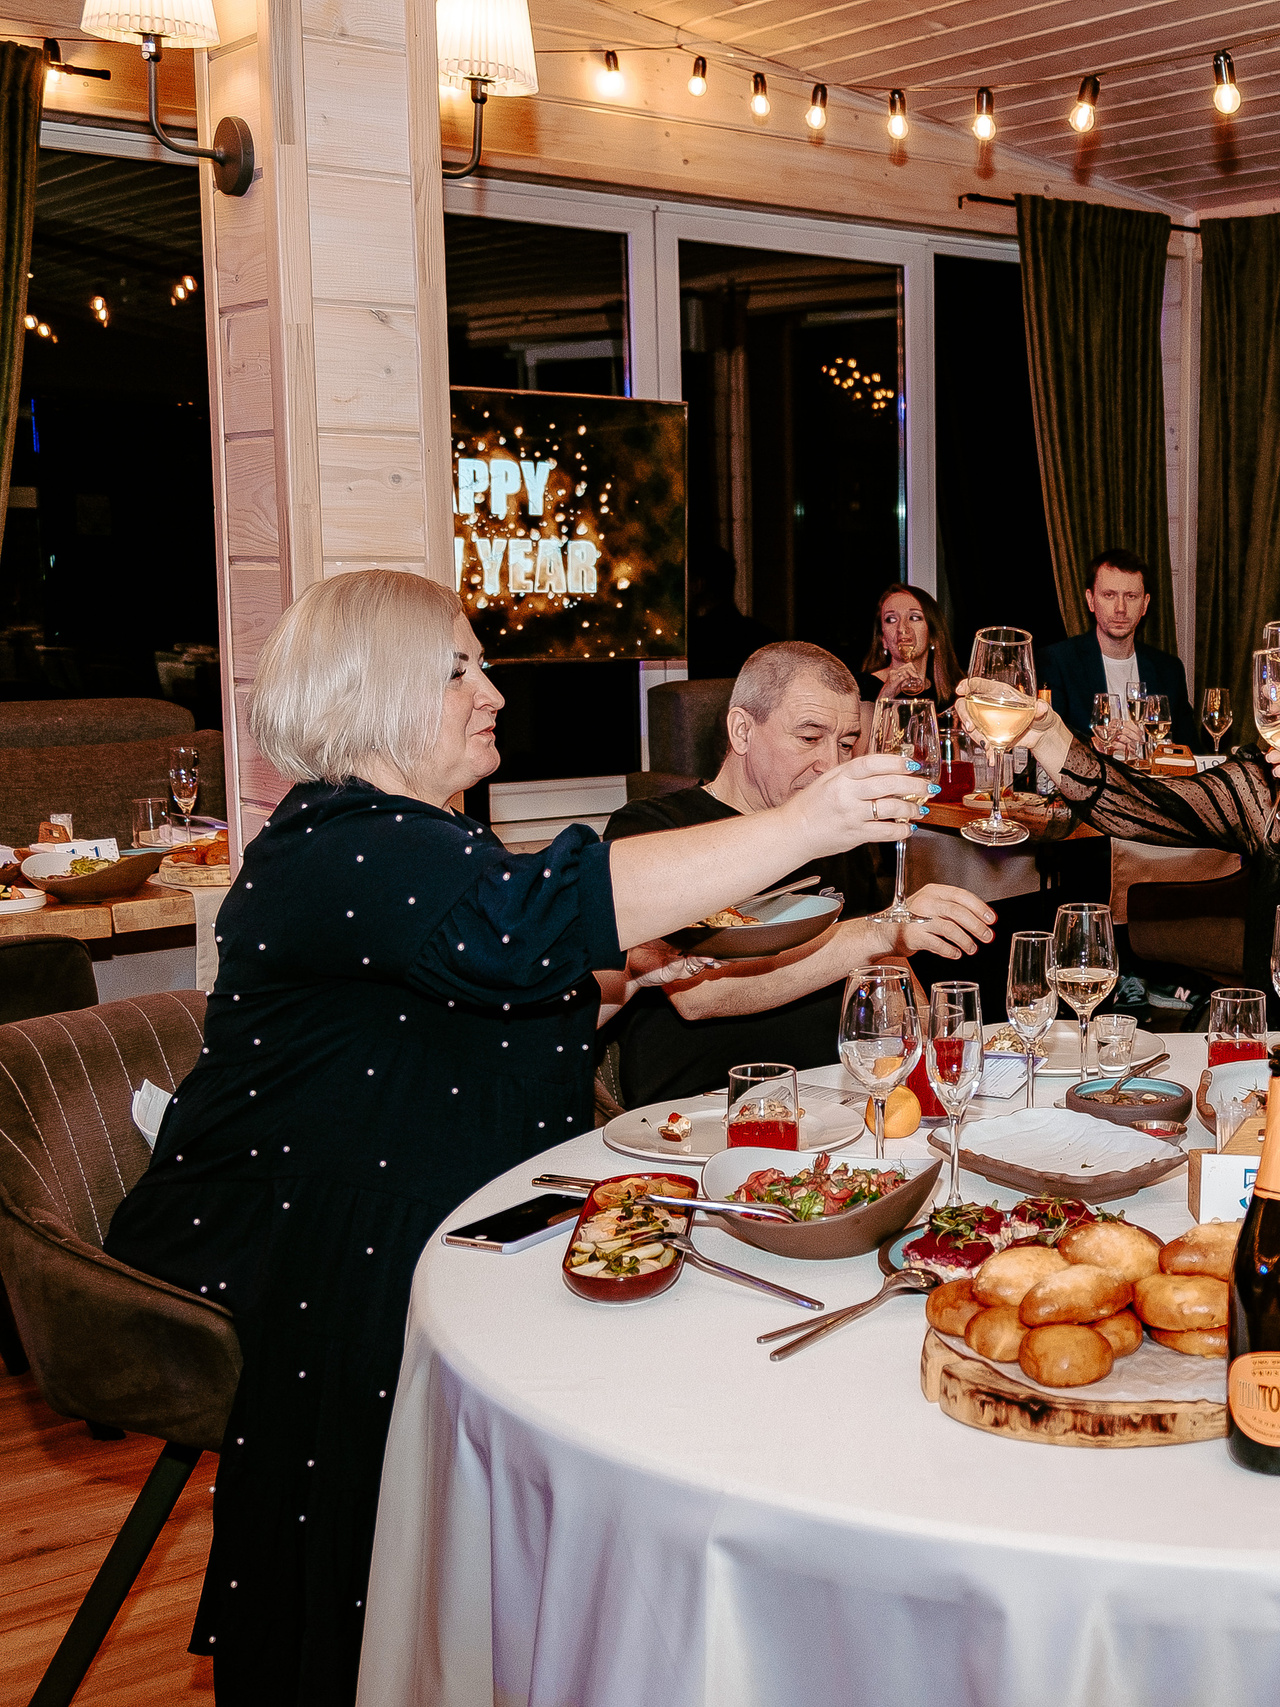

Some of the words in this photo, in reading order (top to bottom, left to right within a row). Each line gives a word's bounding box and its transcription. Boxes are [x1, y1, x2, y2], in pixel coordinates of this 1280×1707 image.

[452, 458, 550, 516] PPY
[475, 538, 598, 594] YEAR
[1174, 986, 1191, 1002] N
